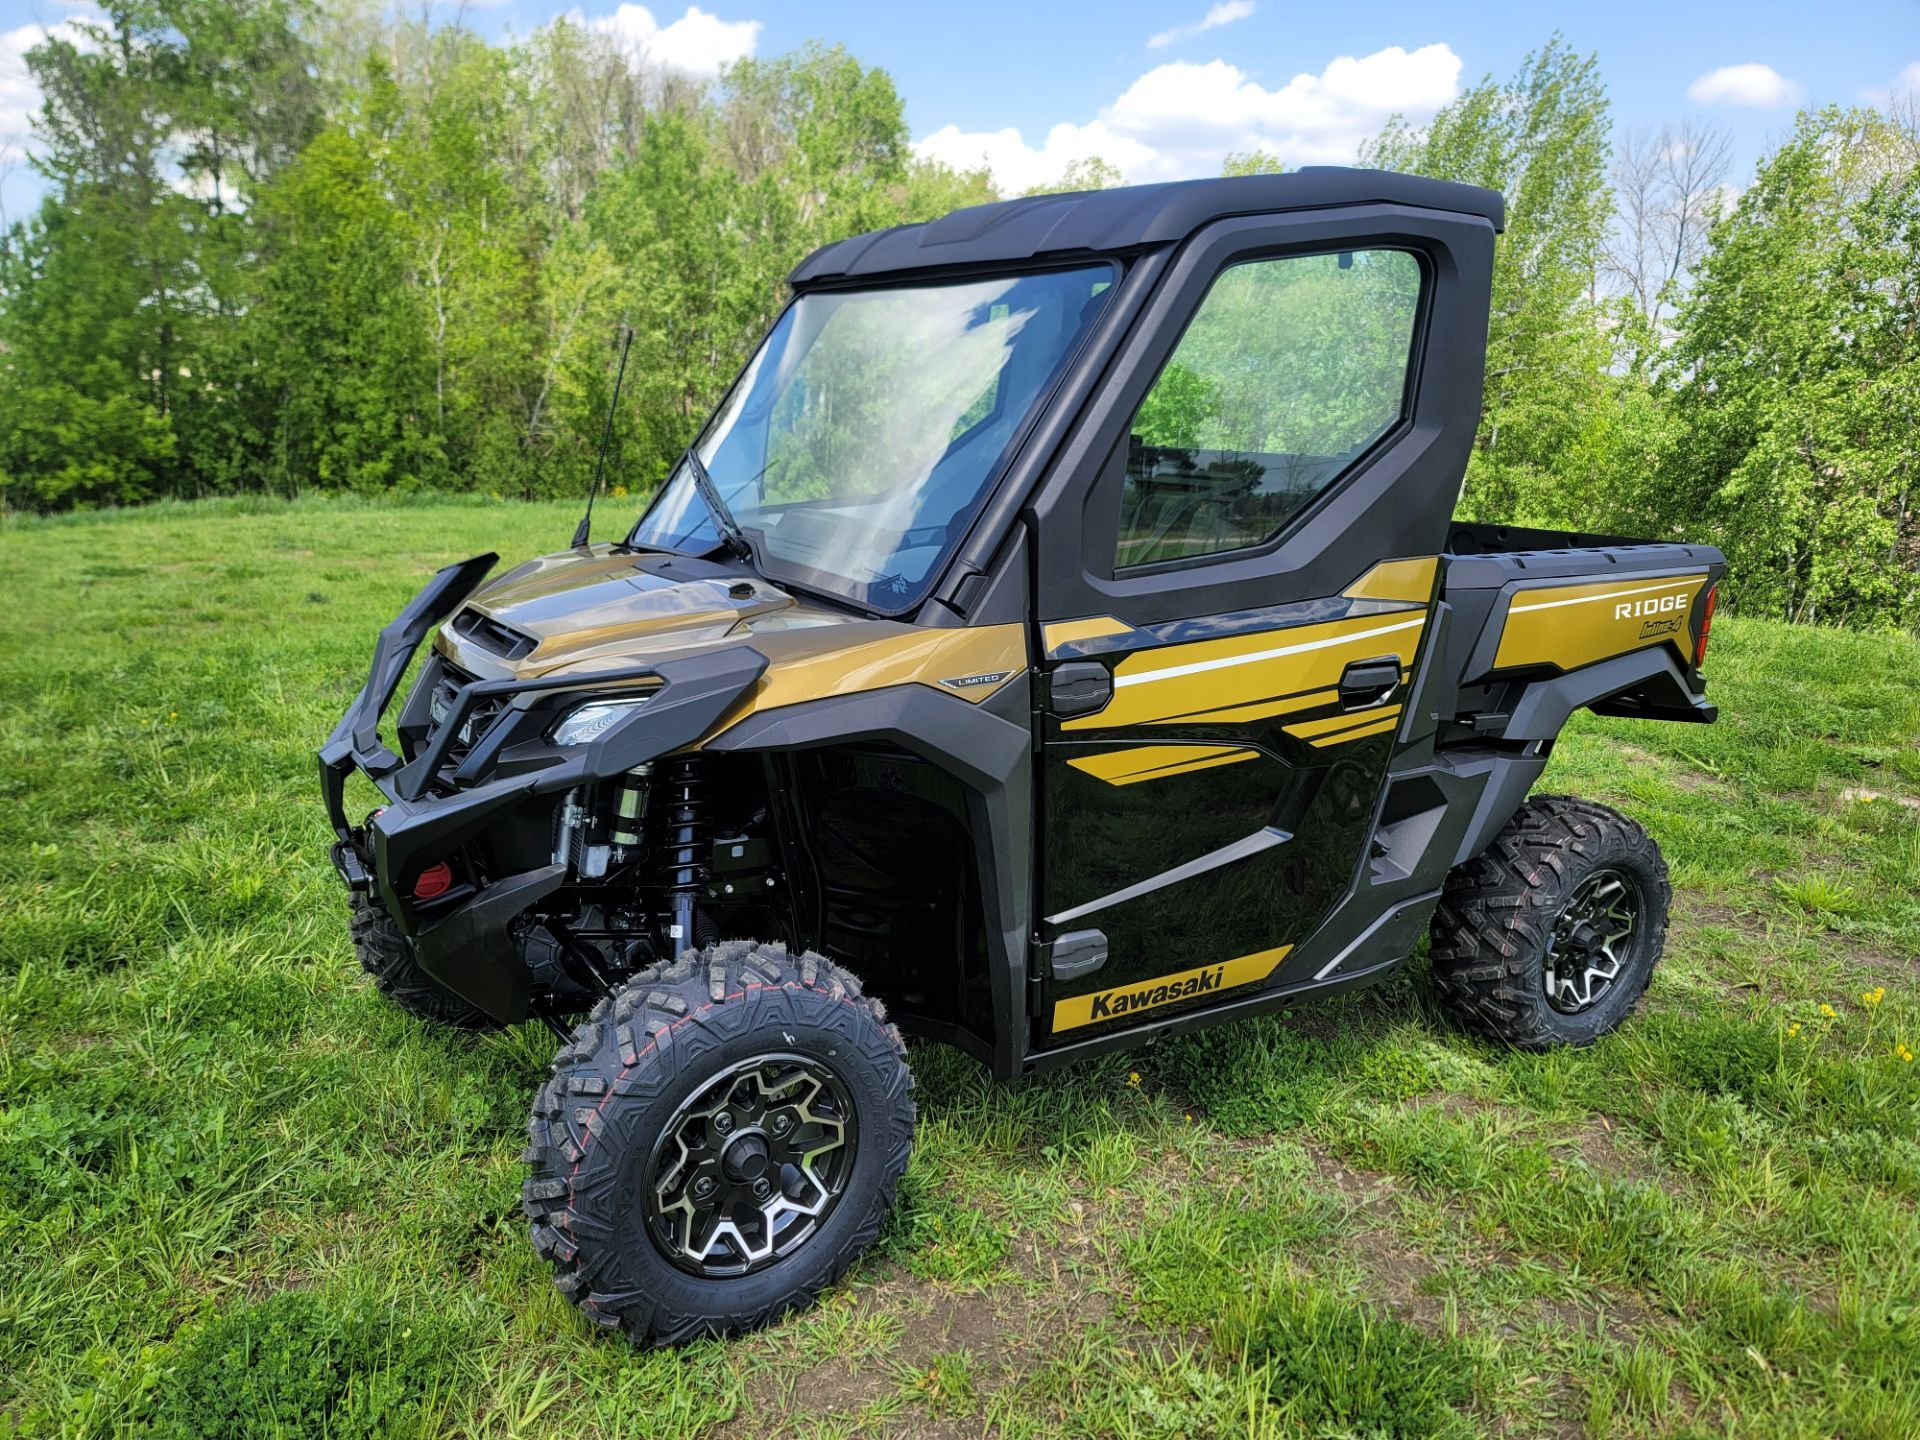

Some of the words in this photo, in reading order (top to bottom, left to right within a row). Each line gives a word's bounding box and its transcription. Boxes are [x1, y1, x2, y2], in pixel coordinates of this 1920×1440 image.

[1615, 593, 1689, 620] RIDGE
[958, 674, 999, 686] LIMITED
[1090, 966, 1224, 1020] Kawasaki
